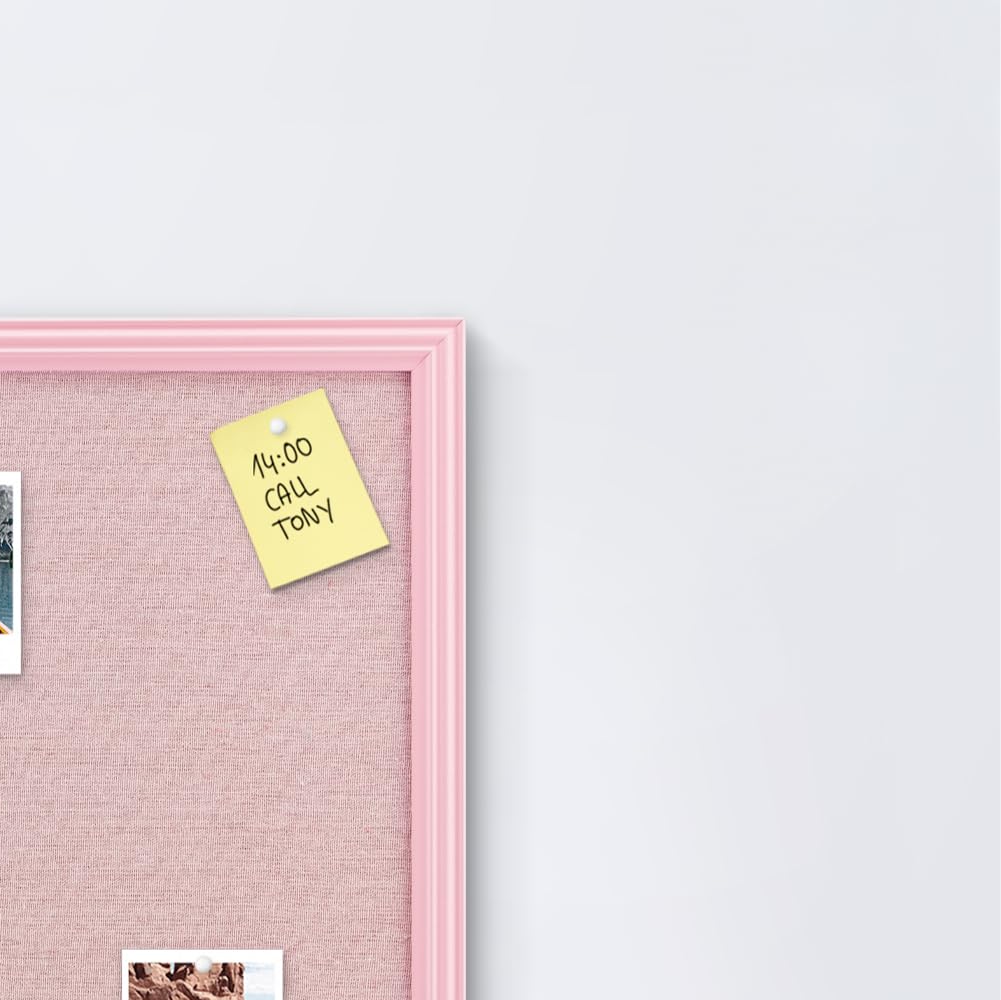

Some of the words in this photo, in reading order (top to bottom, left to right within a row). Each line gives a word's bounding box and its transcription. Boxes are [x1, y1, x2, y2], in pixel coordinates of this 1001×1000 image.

[252, 437, 312, 479] 14:00
[265, 476, 319, 511] CALL
[271, 497, 334, 540] TONY
